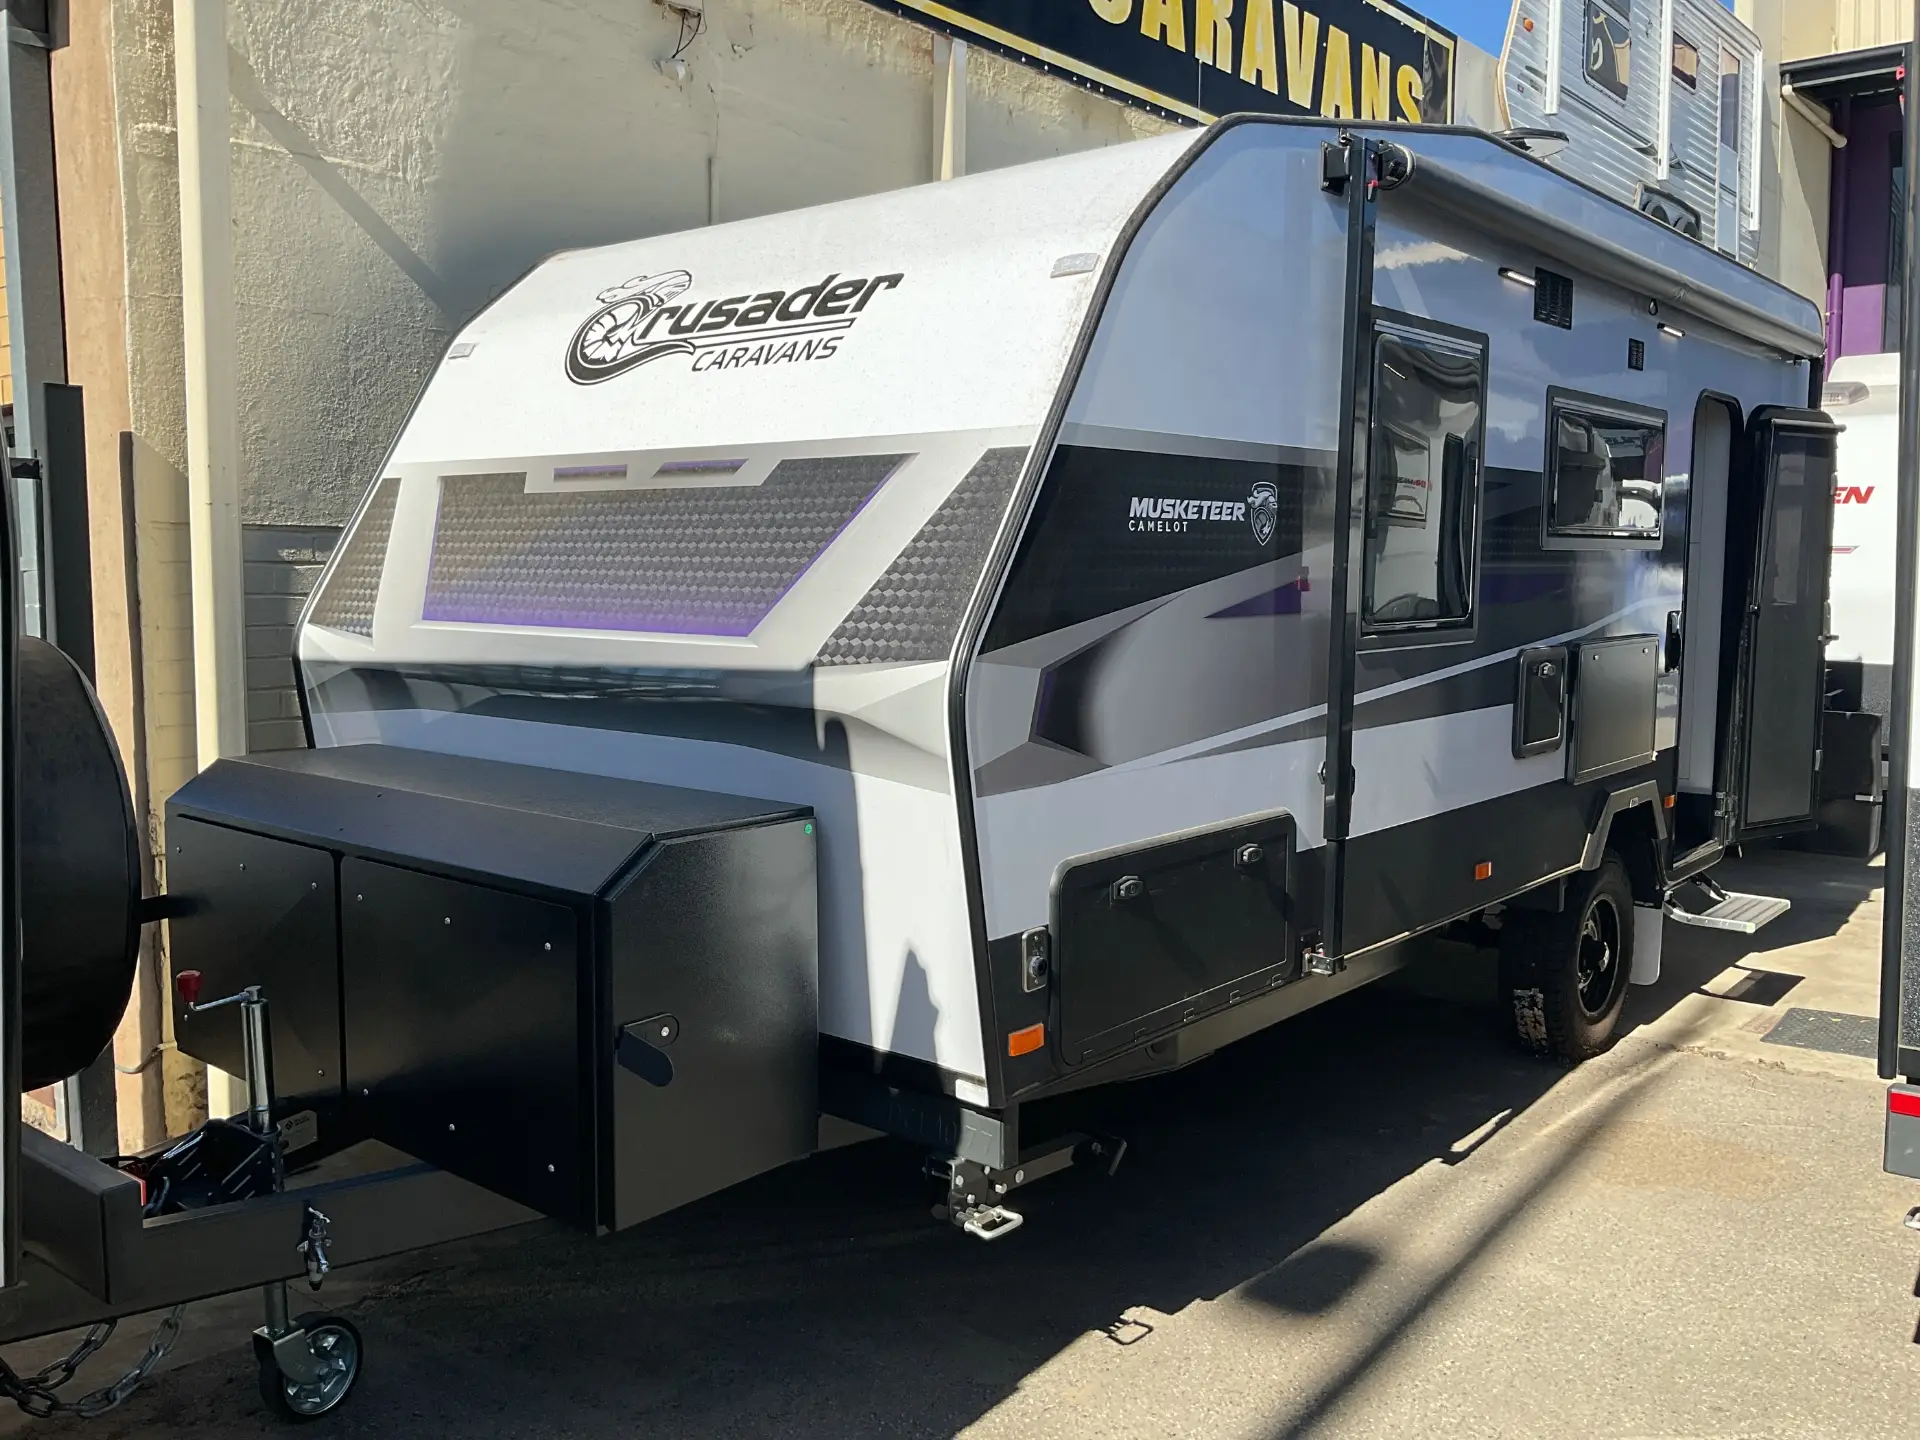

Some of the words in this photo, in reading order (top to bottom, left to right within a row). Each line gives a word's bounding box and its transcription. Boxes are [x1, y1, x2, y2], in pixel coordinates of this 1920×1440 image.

[1088, 0, 1424, 124] ARAVANS
[691, 335, 845, 372] CARAVANS
[1129, 496, 1246, 522] MUSKETEER
[1128, 519, 1189, 532] CAMELOT
